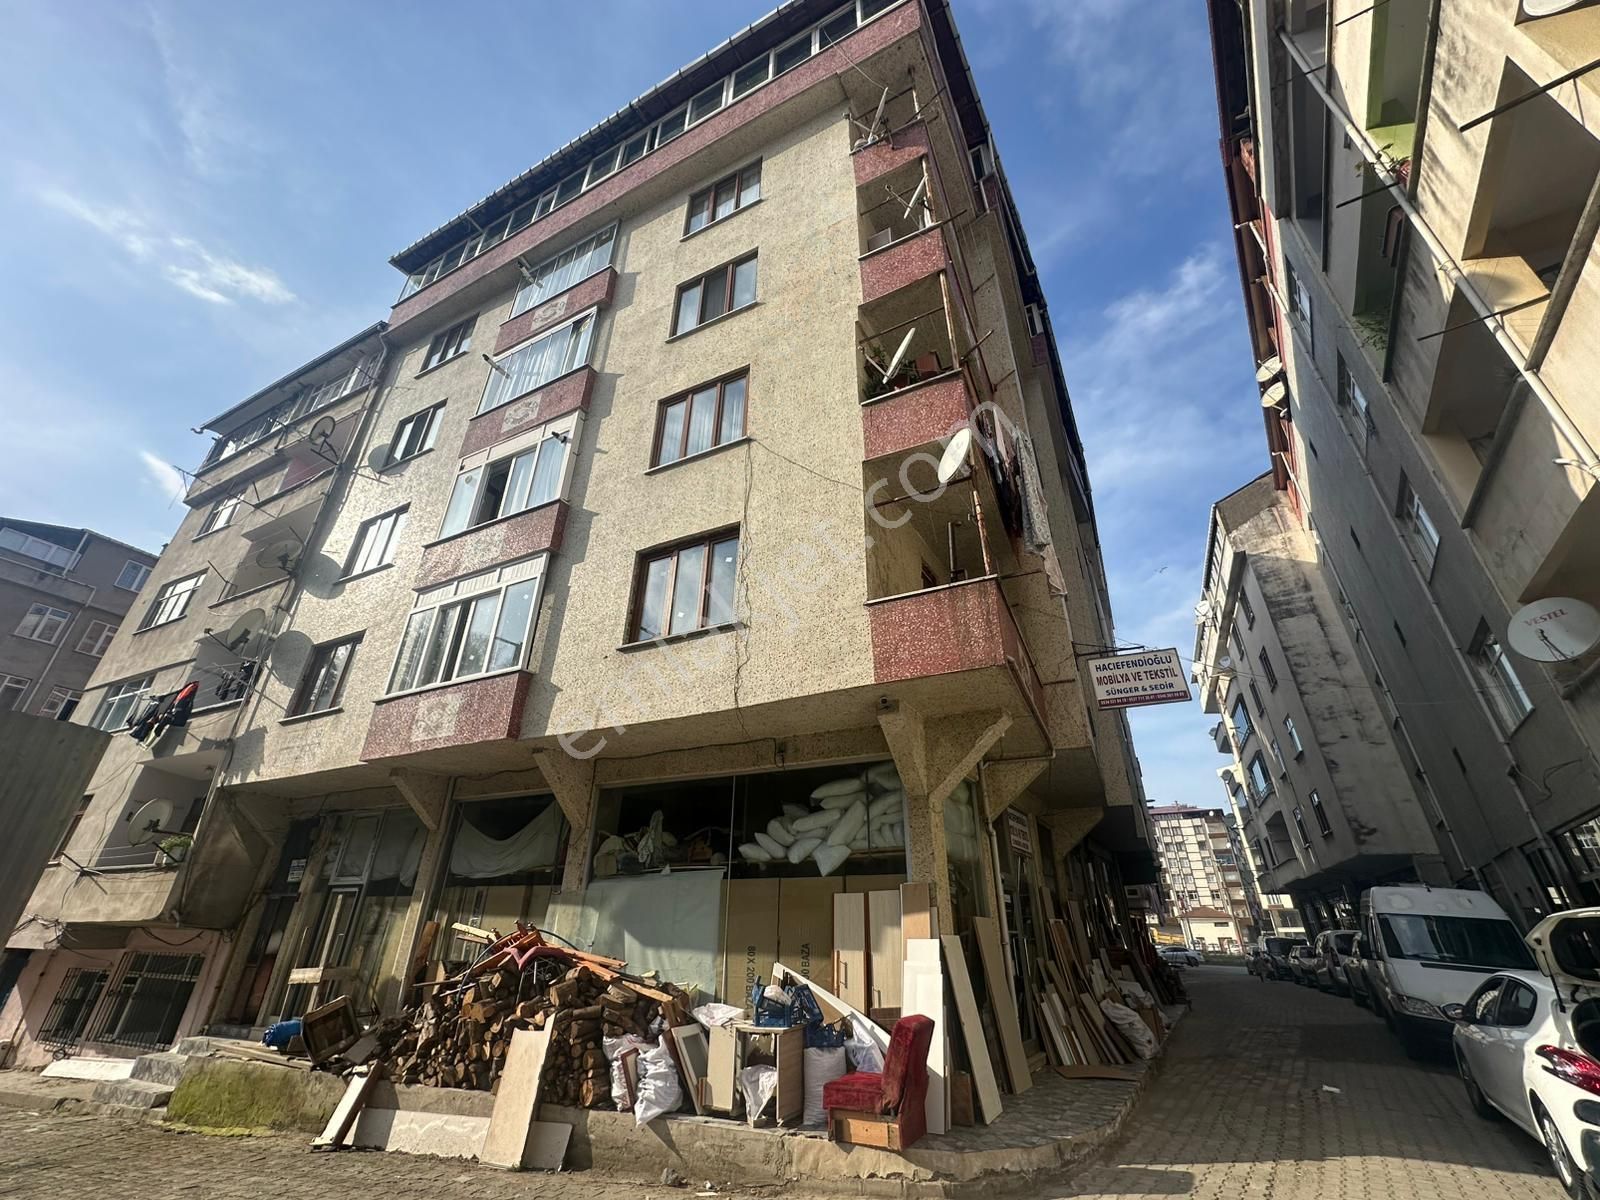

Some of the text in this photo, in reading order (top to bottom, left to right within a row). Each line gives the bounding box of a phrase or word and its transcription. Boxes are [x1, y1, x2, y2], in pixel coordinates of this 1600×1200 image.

[1524, 609, 1568, 625] VESTEL
[1095, 655, 1171, 672] HACIEFENDİOĞLU
[1096, 666, 1178, 686] MOBİLYA VE TEKSTİL
[1105, 683, 1140, 696] SÜNGER
[1149, 681, 1175, 691] SEDİR
[747, 945, 756, 956] 80
[746, 967, 755, 983] 200
